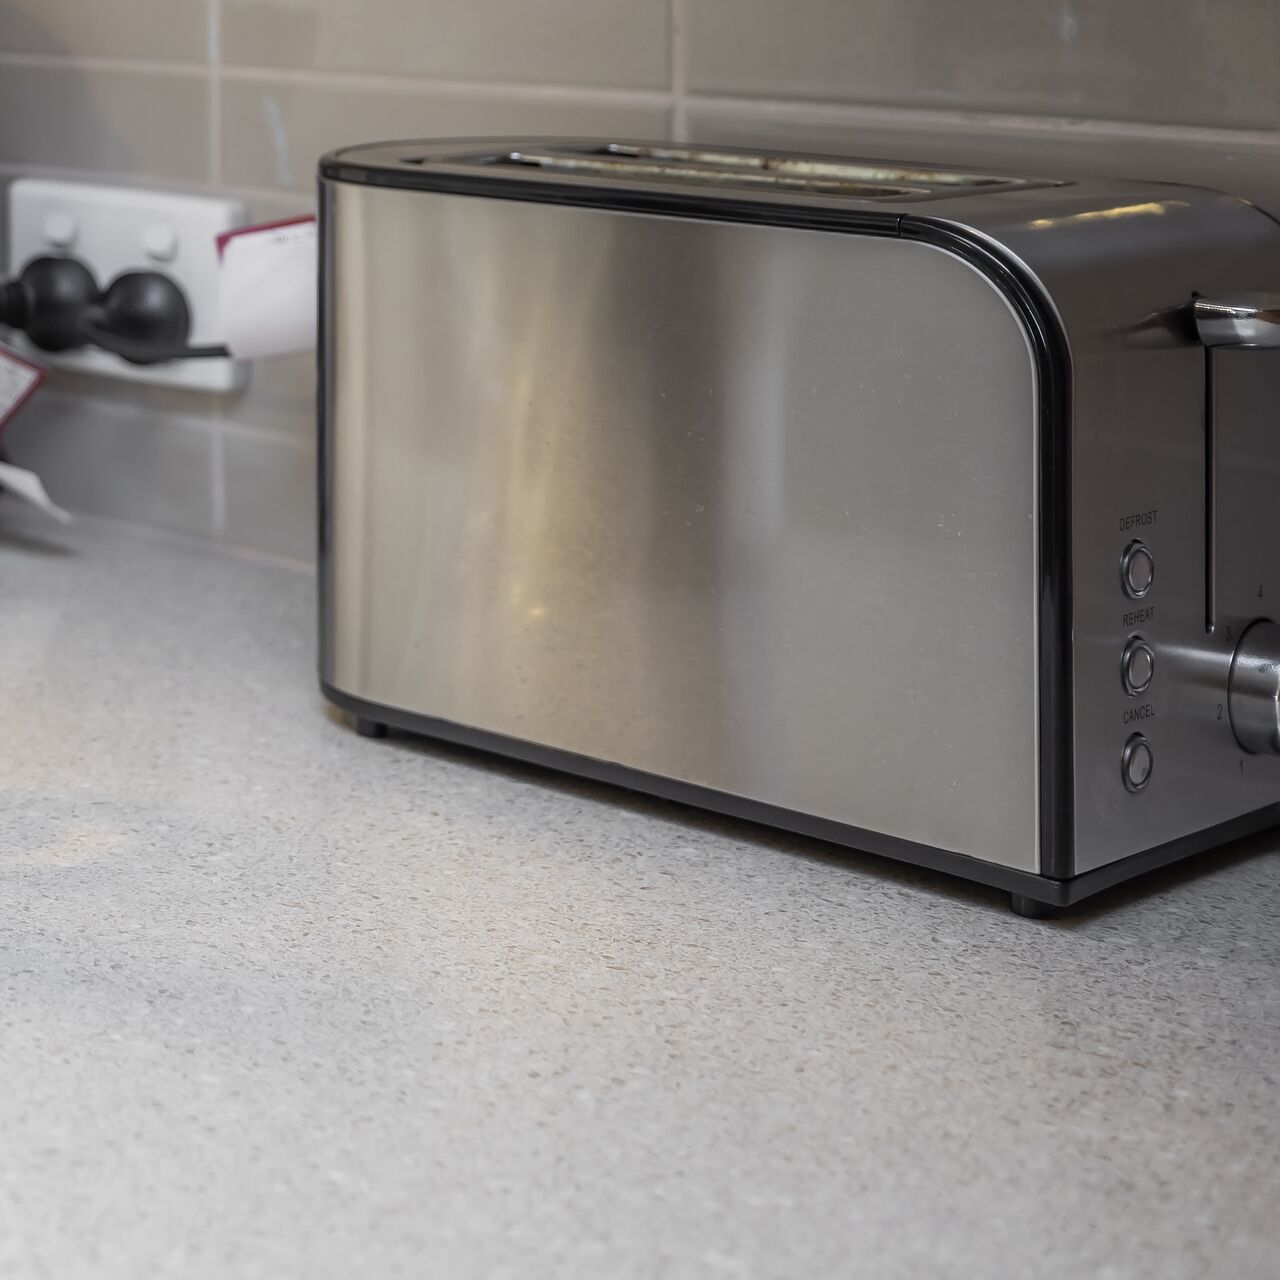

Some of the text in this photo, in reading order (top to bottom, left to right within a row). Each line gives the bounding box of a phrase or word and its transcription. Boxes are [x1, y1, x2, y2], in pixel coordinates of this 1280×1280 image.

[1119, 510, 1158, 531] DEFROST
[1257, 584, 1264, 599] 4
[1122, 607, 1155, 626] REHEAT
[1123, 704, 1155, 725] CANCEL
[1217, 704, 1223, 720] 2
[1239, 760, 1244, 775] 1
